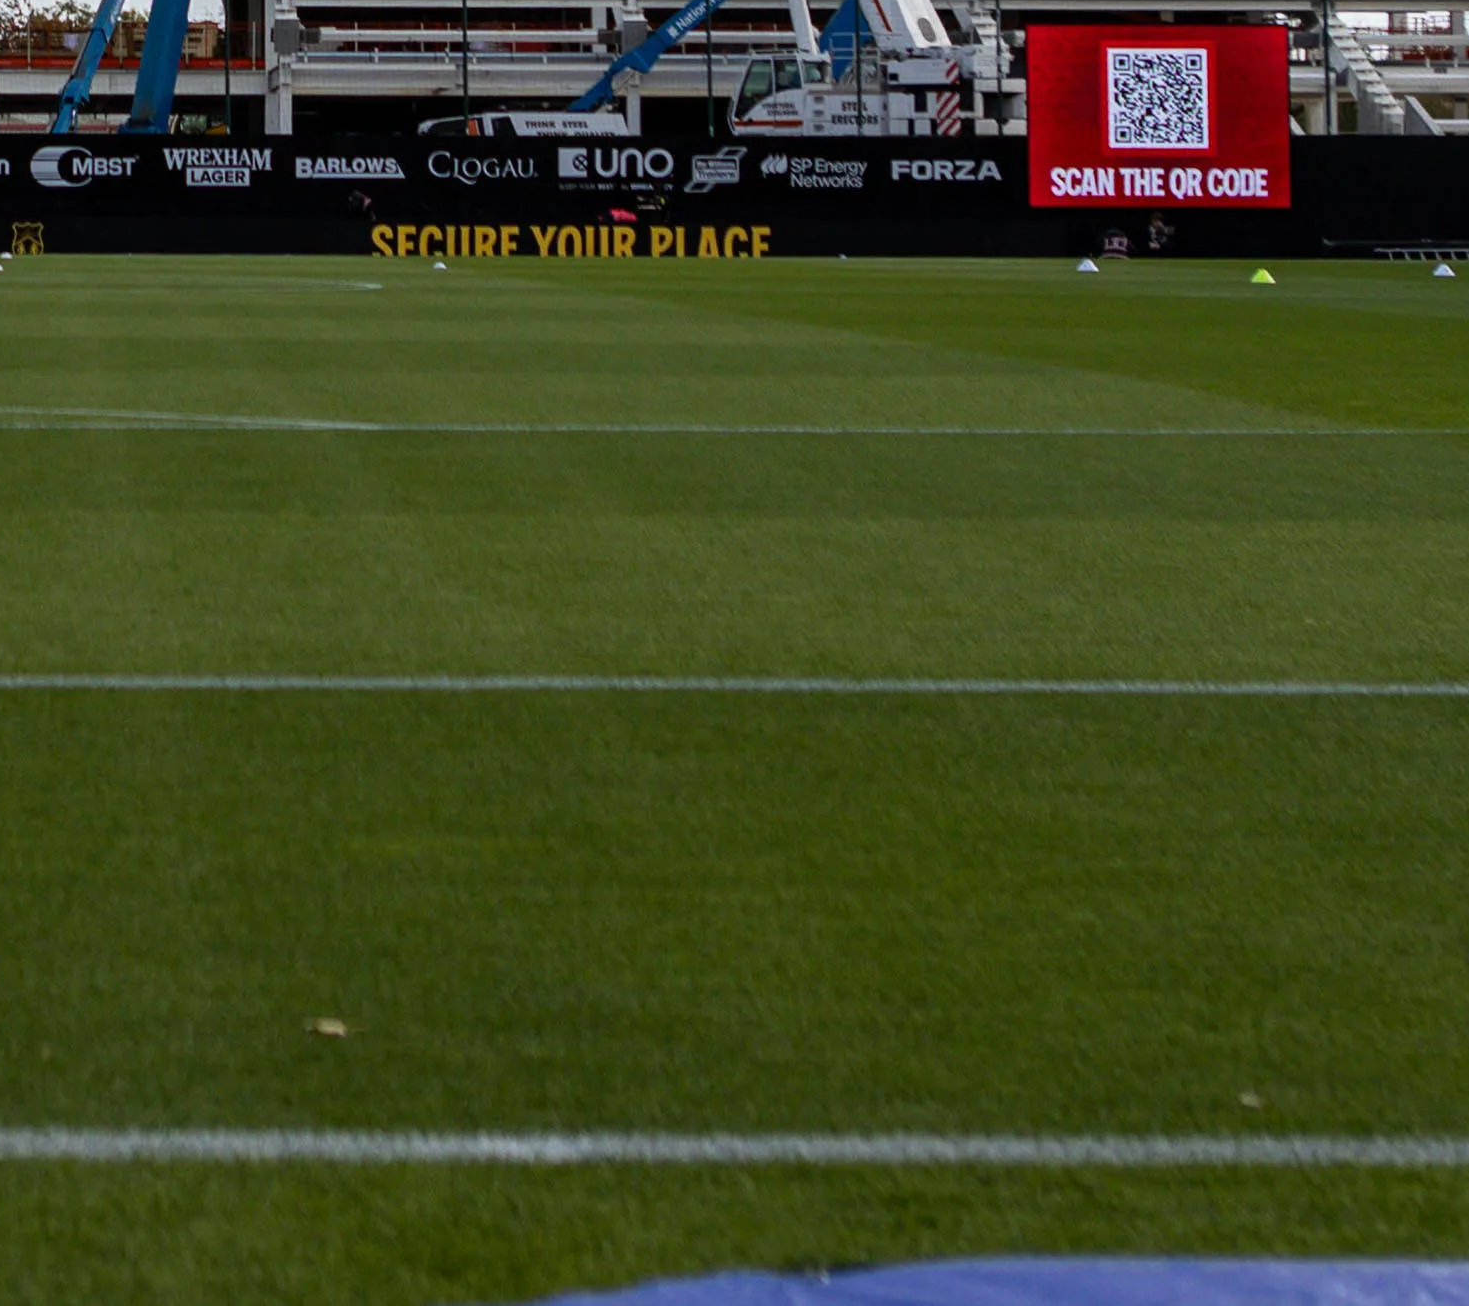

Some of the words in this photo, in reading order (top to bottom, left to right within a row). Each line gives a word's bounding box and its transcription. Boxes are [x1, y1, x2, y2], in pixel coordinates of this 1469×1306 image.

[72, 157, 135, 176] MBST
[163, 148, 273, 171] WREXHAM
[295, 157, 398, 178] BARLOWS
[790, 157, 812, 174] SP
[815, 158, 867, 176] Energy
[190, 170, 246, 184] LAGER
[891, 160, 1002, 180] FORZA
[790, 173, 863, 188] Networks
[1050, 167, 1114, 197] SCAN
[1120, 167, 1165, 196] THE
[1169, 168, 1202, 199] QR
[1207, 168, 1269, 197] CODE
[371, 224, 521, 259] SECURE
[529, 225, 637, 259] YOUR
[650, 225, 772, 259] PLACE
